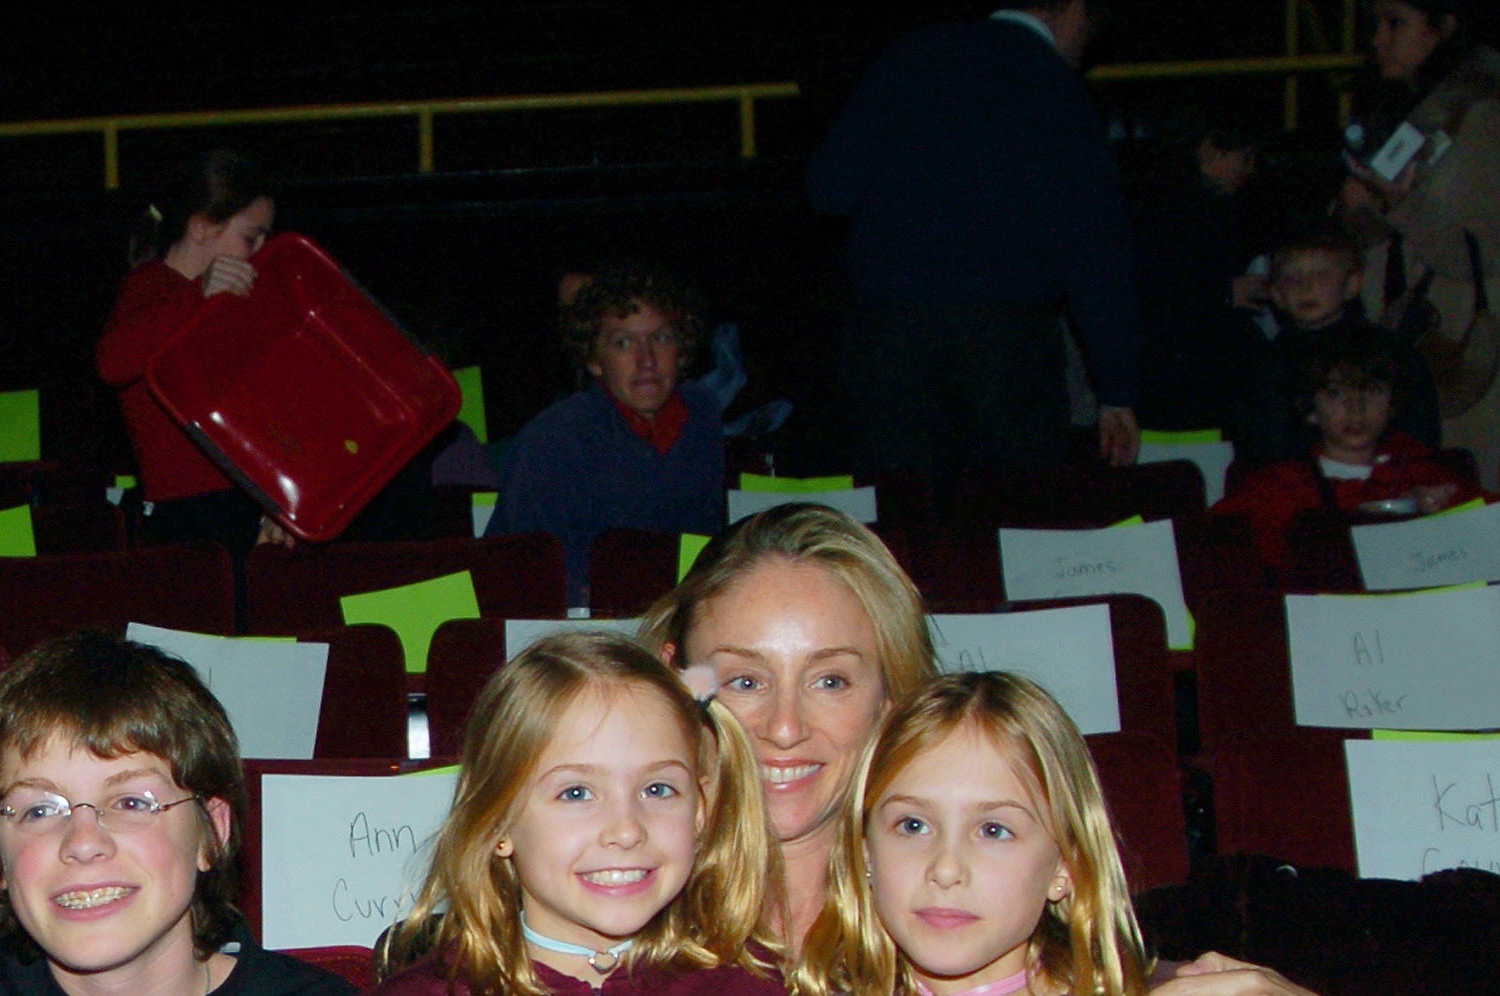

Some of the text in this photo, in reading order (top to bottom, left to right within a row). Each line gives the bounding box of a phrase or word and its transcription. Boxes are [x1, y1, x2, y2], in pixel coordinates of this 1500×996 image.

[1350, 628, 1385, 666] Al
[348, 810, 418, 859] Ann
[331, 877, 417, 923] Cur
